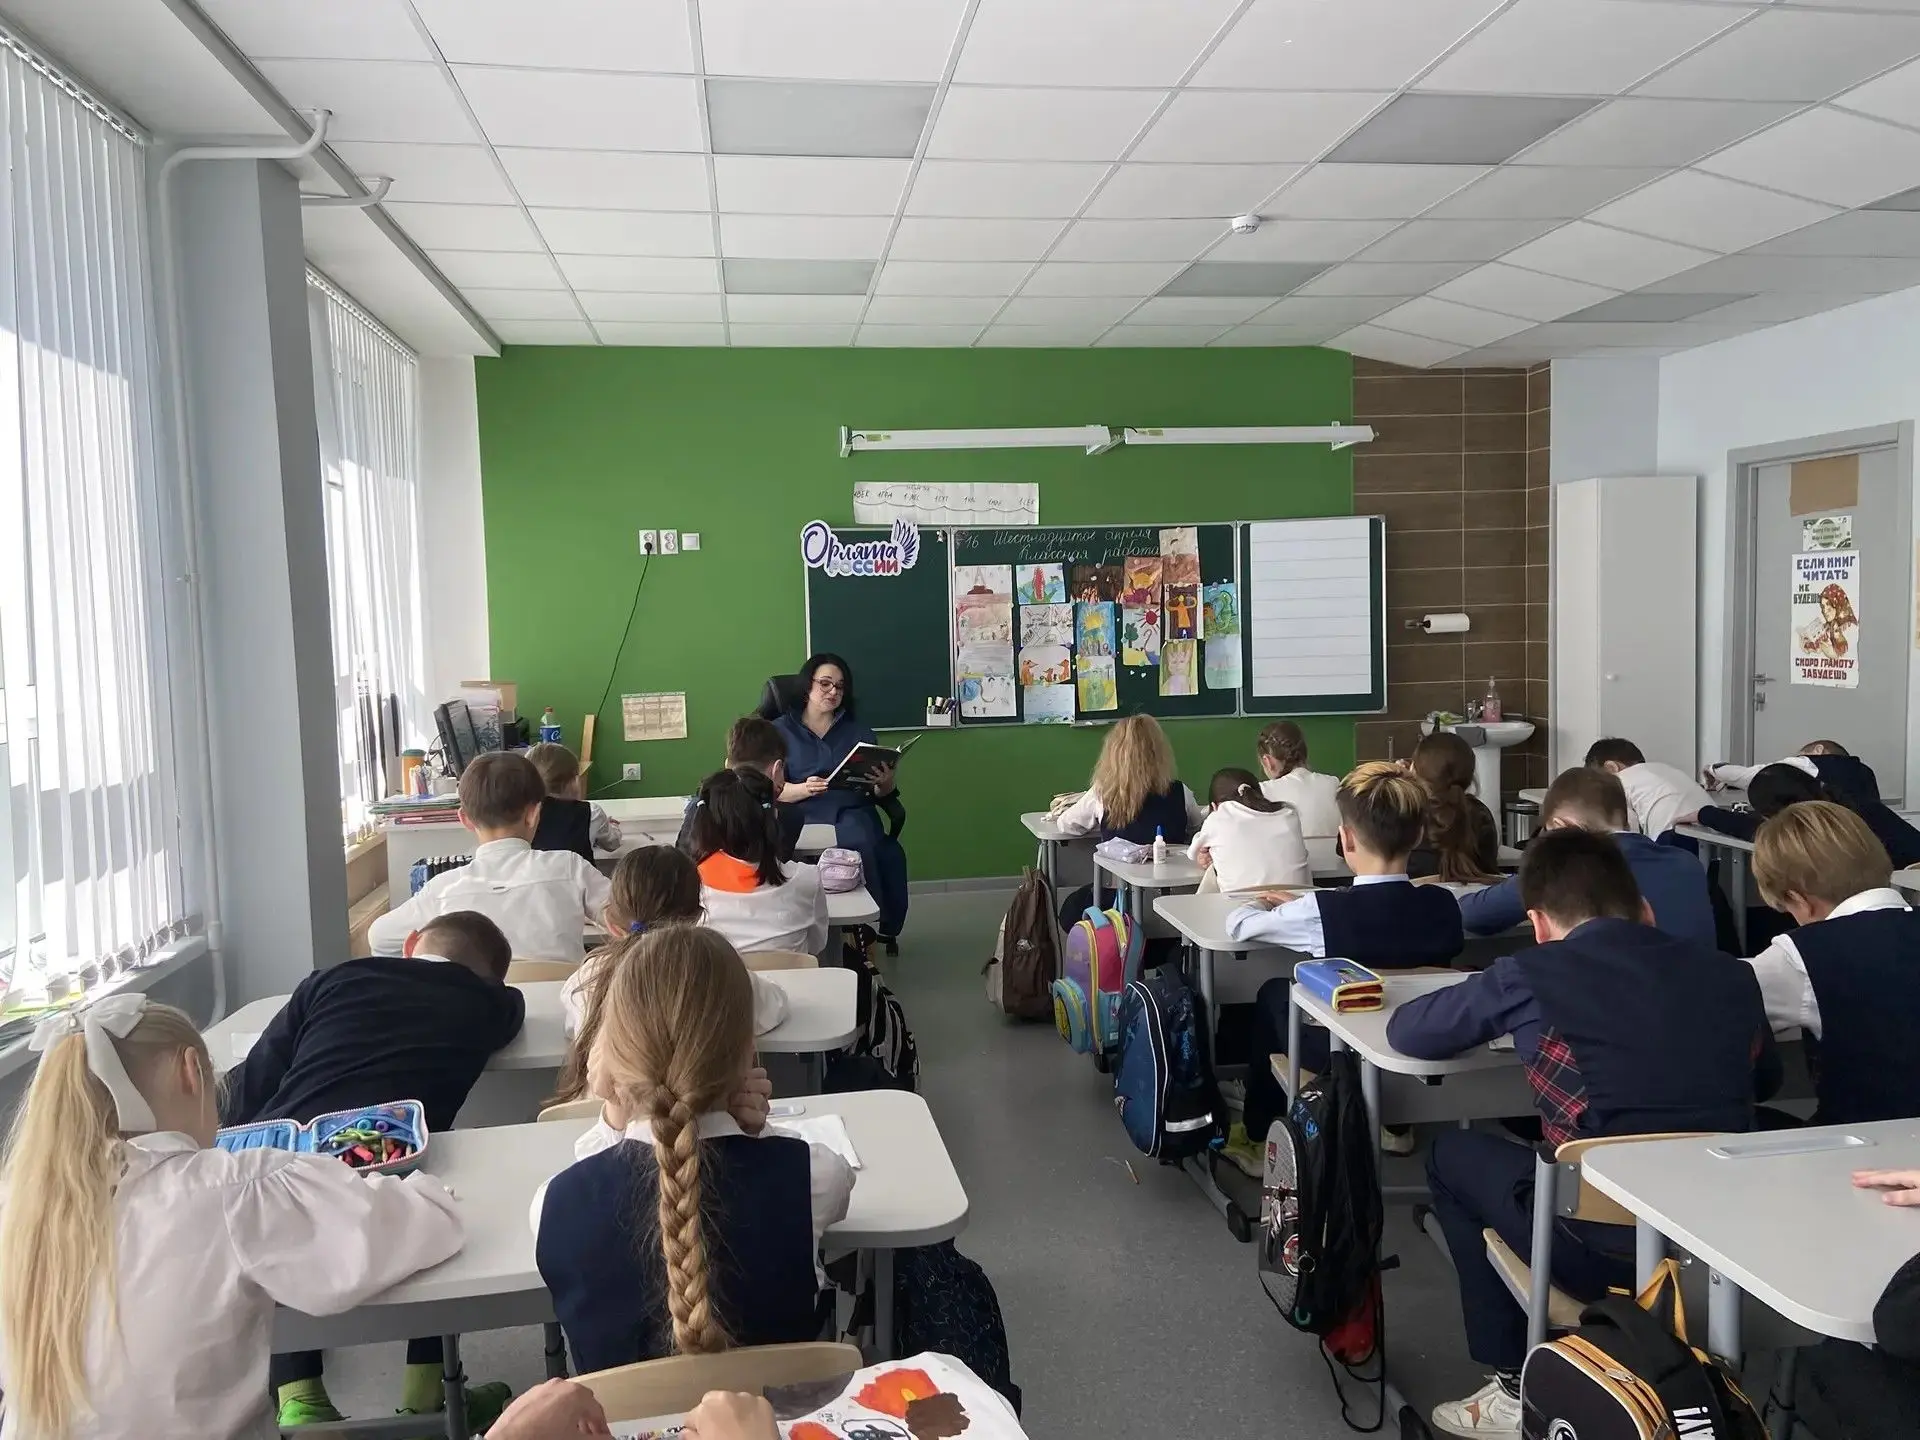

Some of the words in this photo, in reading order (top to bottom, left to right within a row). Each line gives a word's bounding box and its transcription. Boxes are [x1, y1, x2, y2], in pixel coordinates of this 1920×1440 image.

[803, 522, 897, 568] Орлята
[966, 534, 979, 549] 16
[993, 530, 1096, 551] Шестнадцатое
[1104, 528, 1152, 547] апреля
[1019, 543, 1089, 560] Классная
[1101, 539, 1160, 566] работа
[828, 560, 898, 574] РОССИИ
[1796, 558, 1825, 570] ЕСЛИ
[1803, 569, 1848, 581] ЧИТАТЬ
[1798, 584, 1810, 592] НЕ
[1795, 658, 1819, 667] СКОРО
[1820, 658, 1855, 669] ГРАМОТУ
[1801, 668, 1848, 680] ЗАБУДЕШЬ
